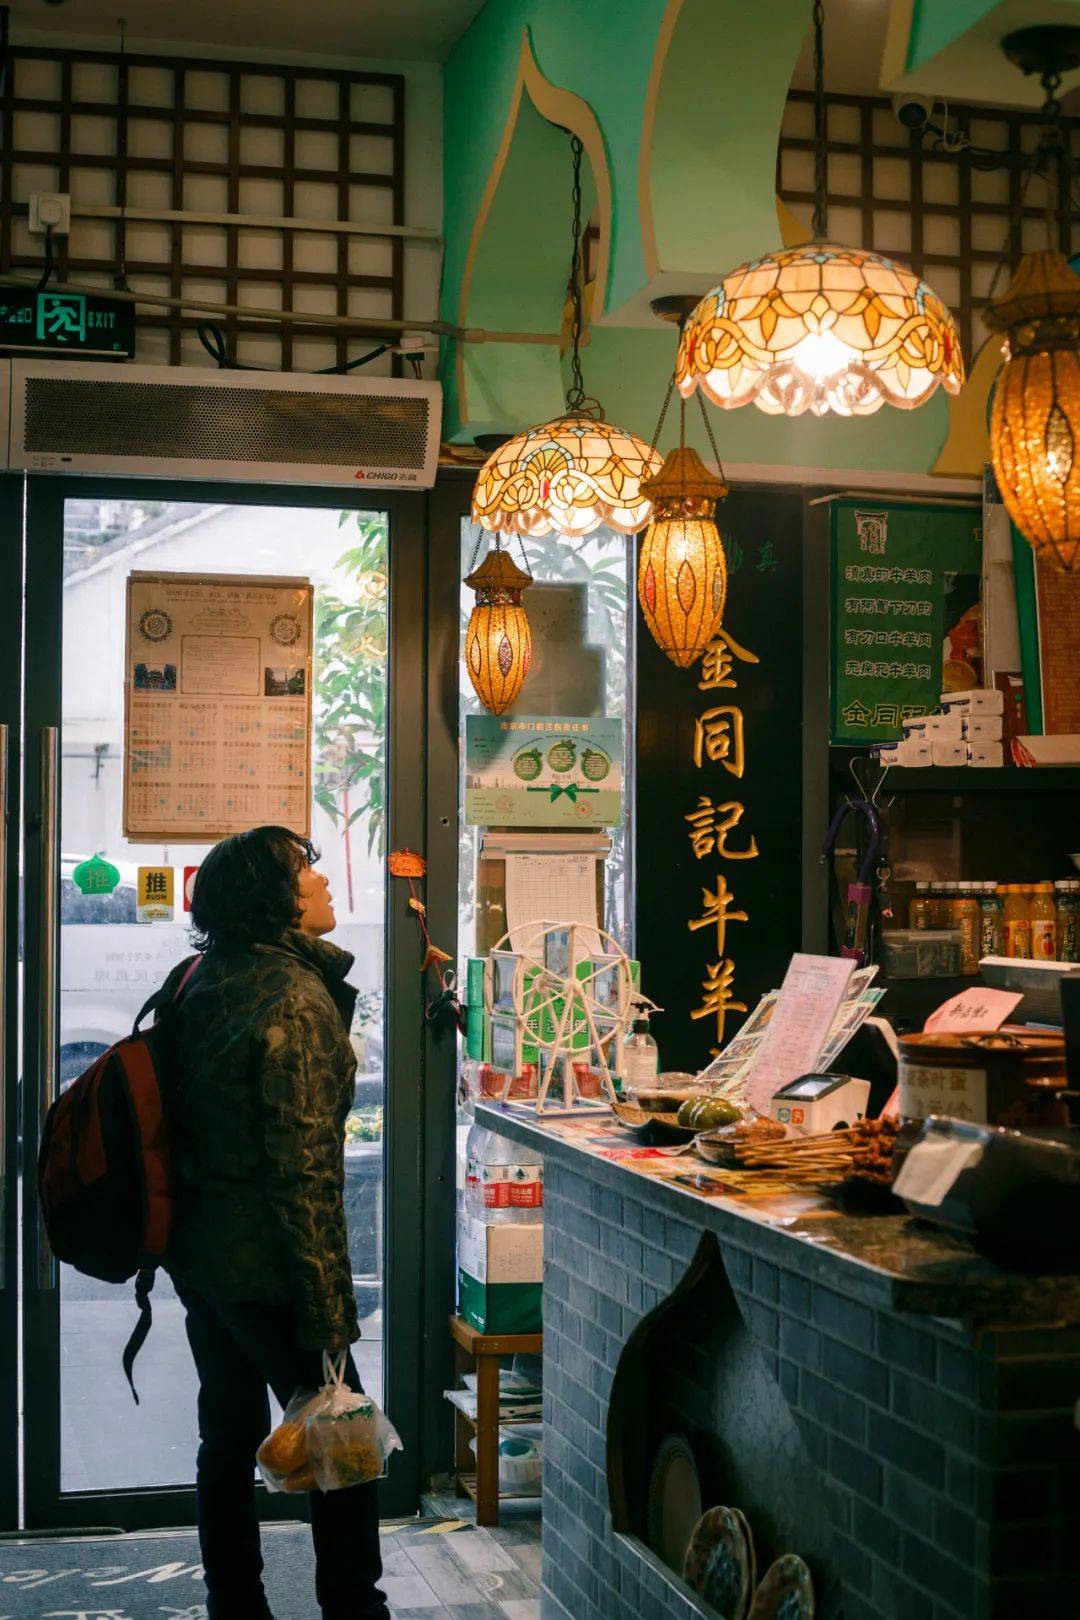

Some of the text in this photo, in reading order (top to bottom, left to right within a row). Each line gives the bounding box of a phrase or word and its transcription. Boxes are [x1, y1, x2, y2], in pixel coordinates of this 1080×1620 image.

[87, 311, 116, 329] EXIT
[366, 471, 398, 481] CHIGO
[844, 565, 933, 585] 清真的牛羊肉
[844, 629, 933, 649] 有刀口牛羊肉
[844, 660, 932, 680] 无病死牛羊肉
[684, 628, 760, 1060] 金同記牛羊
[84, 865, 110, 889] 推
[145, 872, 167, 893] 推
[145, 893, 167, 901] PUSH
